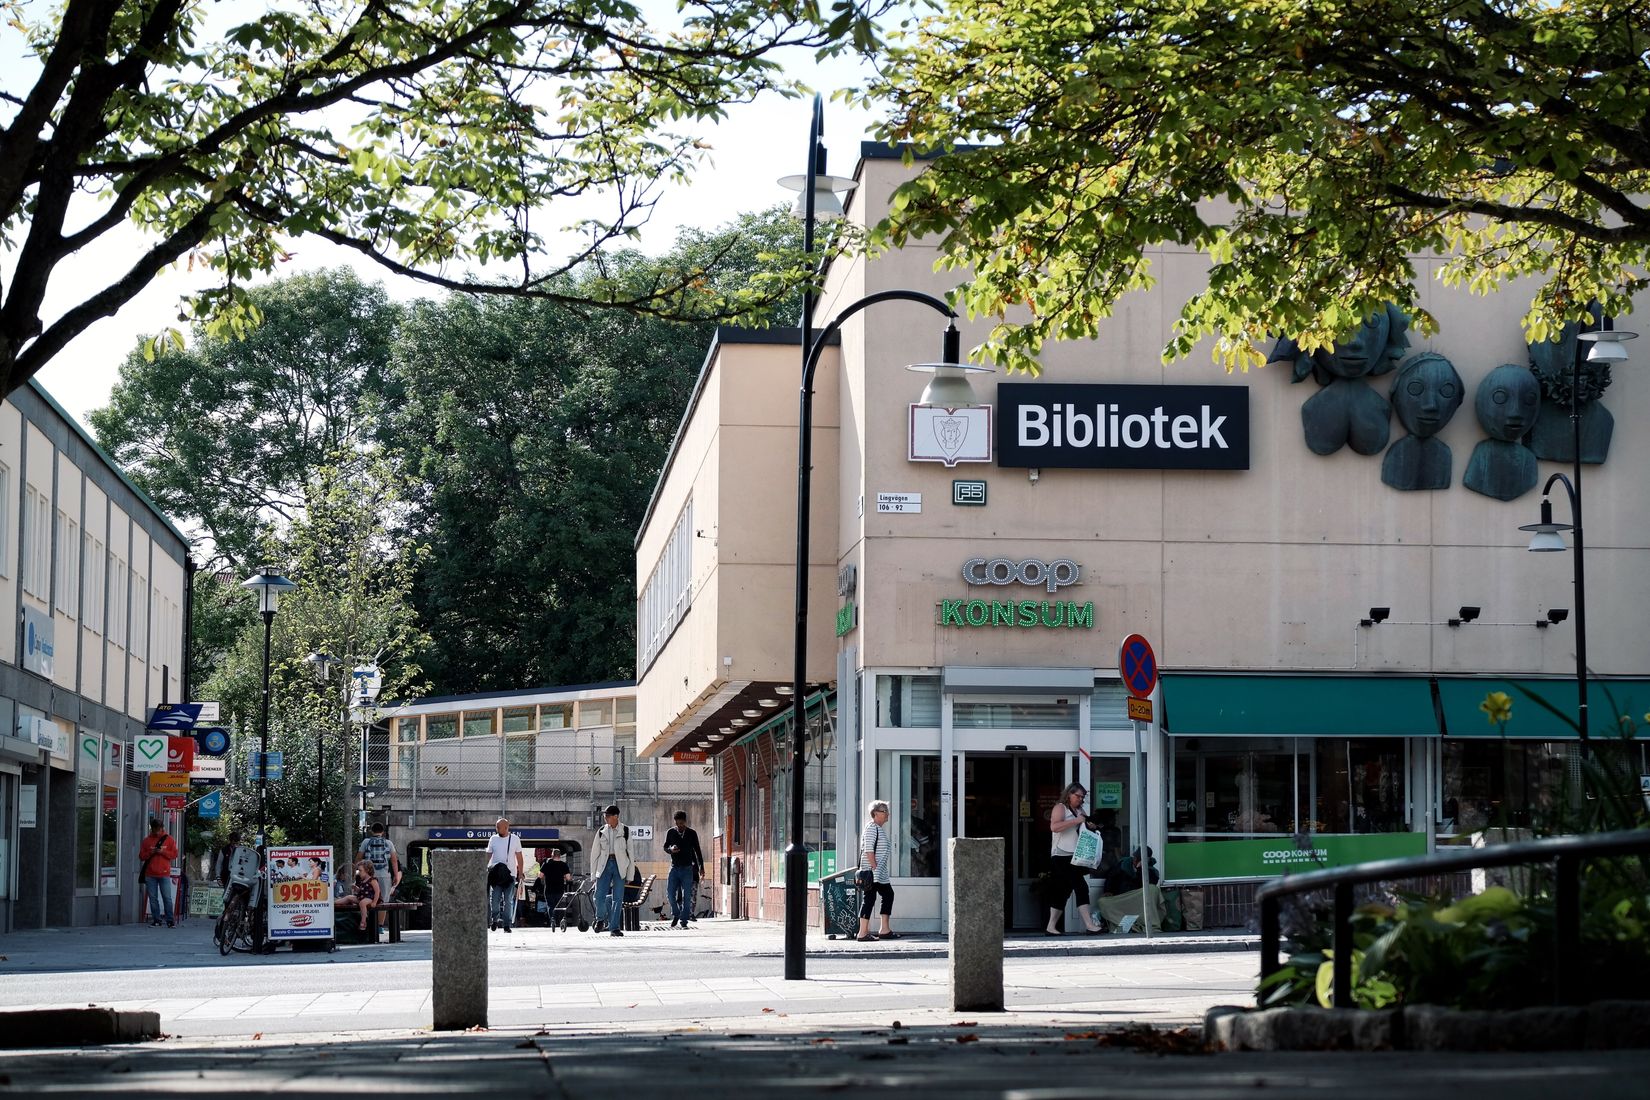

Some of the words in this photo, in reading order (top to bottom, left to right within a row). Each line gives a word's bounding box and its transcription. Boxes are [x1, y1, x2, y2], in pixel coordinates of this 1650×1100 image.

[1018, 404, 1229, 449] Bibliotek
[962, 558, 1081, 593] coop
[941, 599, 1094, 628] KONSUM
[1262, 850, 1291, 860] coop
[280, 883, 321, 902] 99kr
